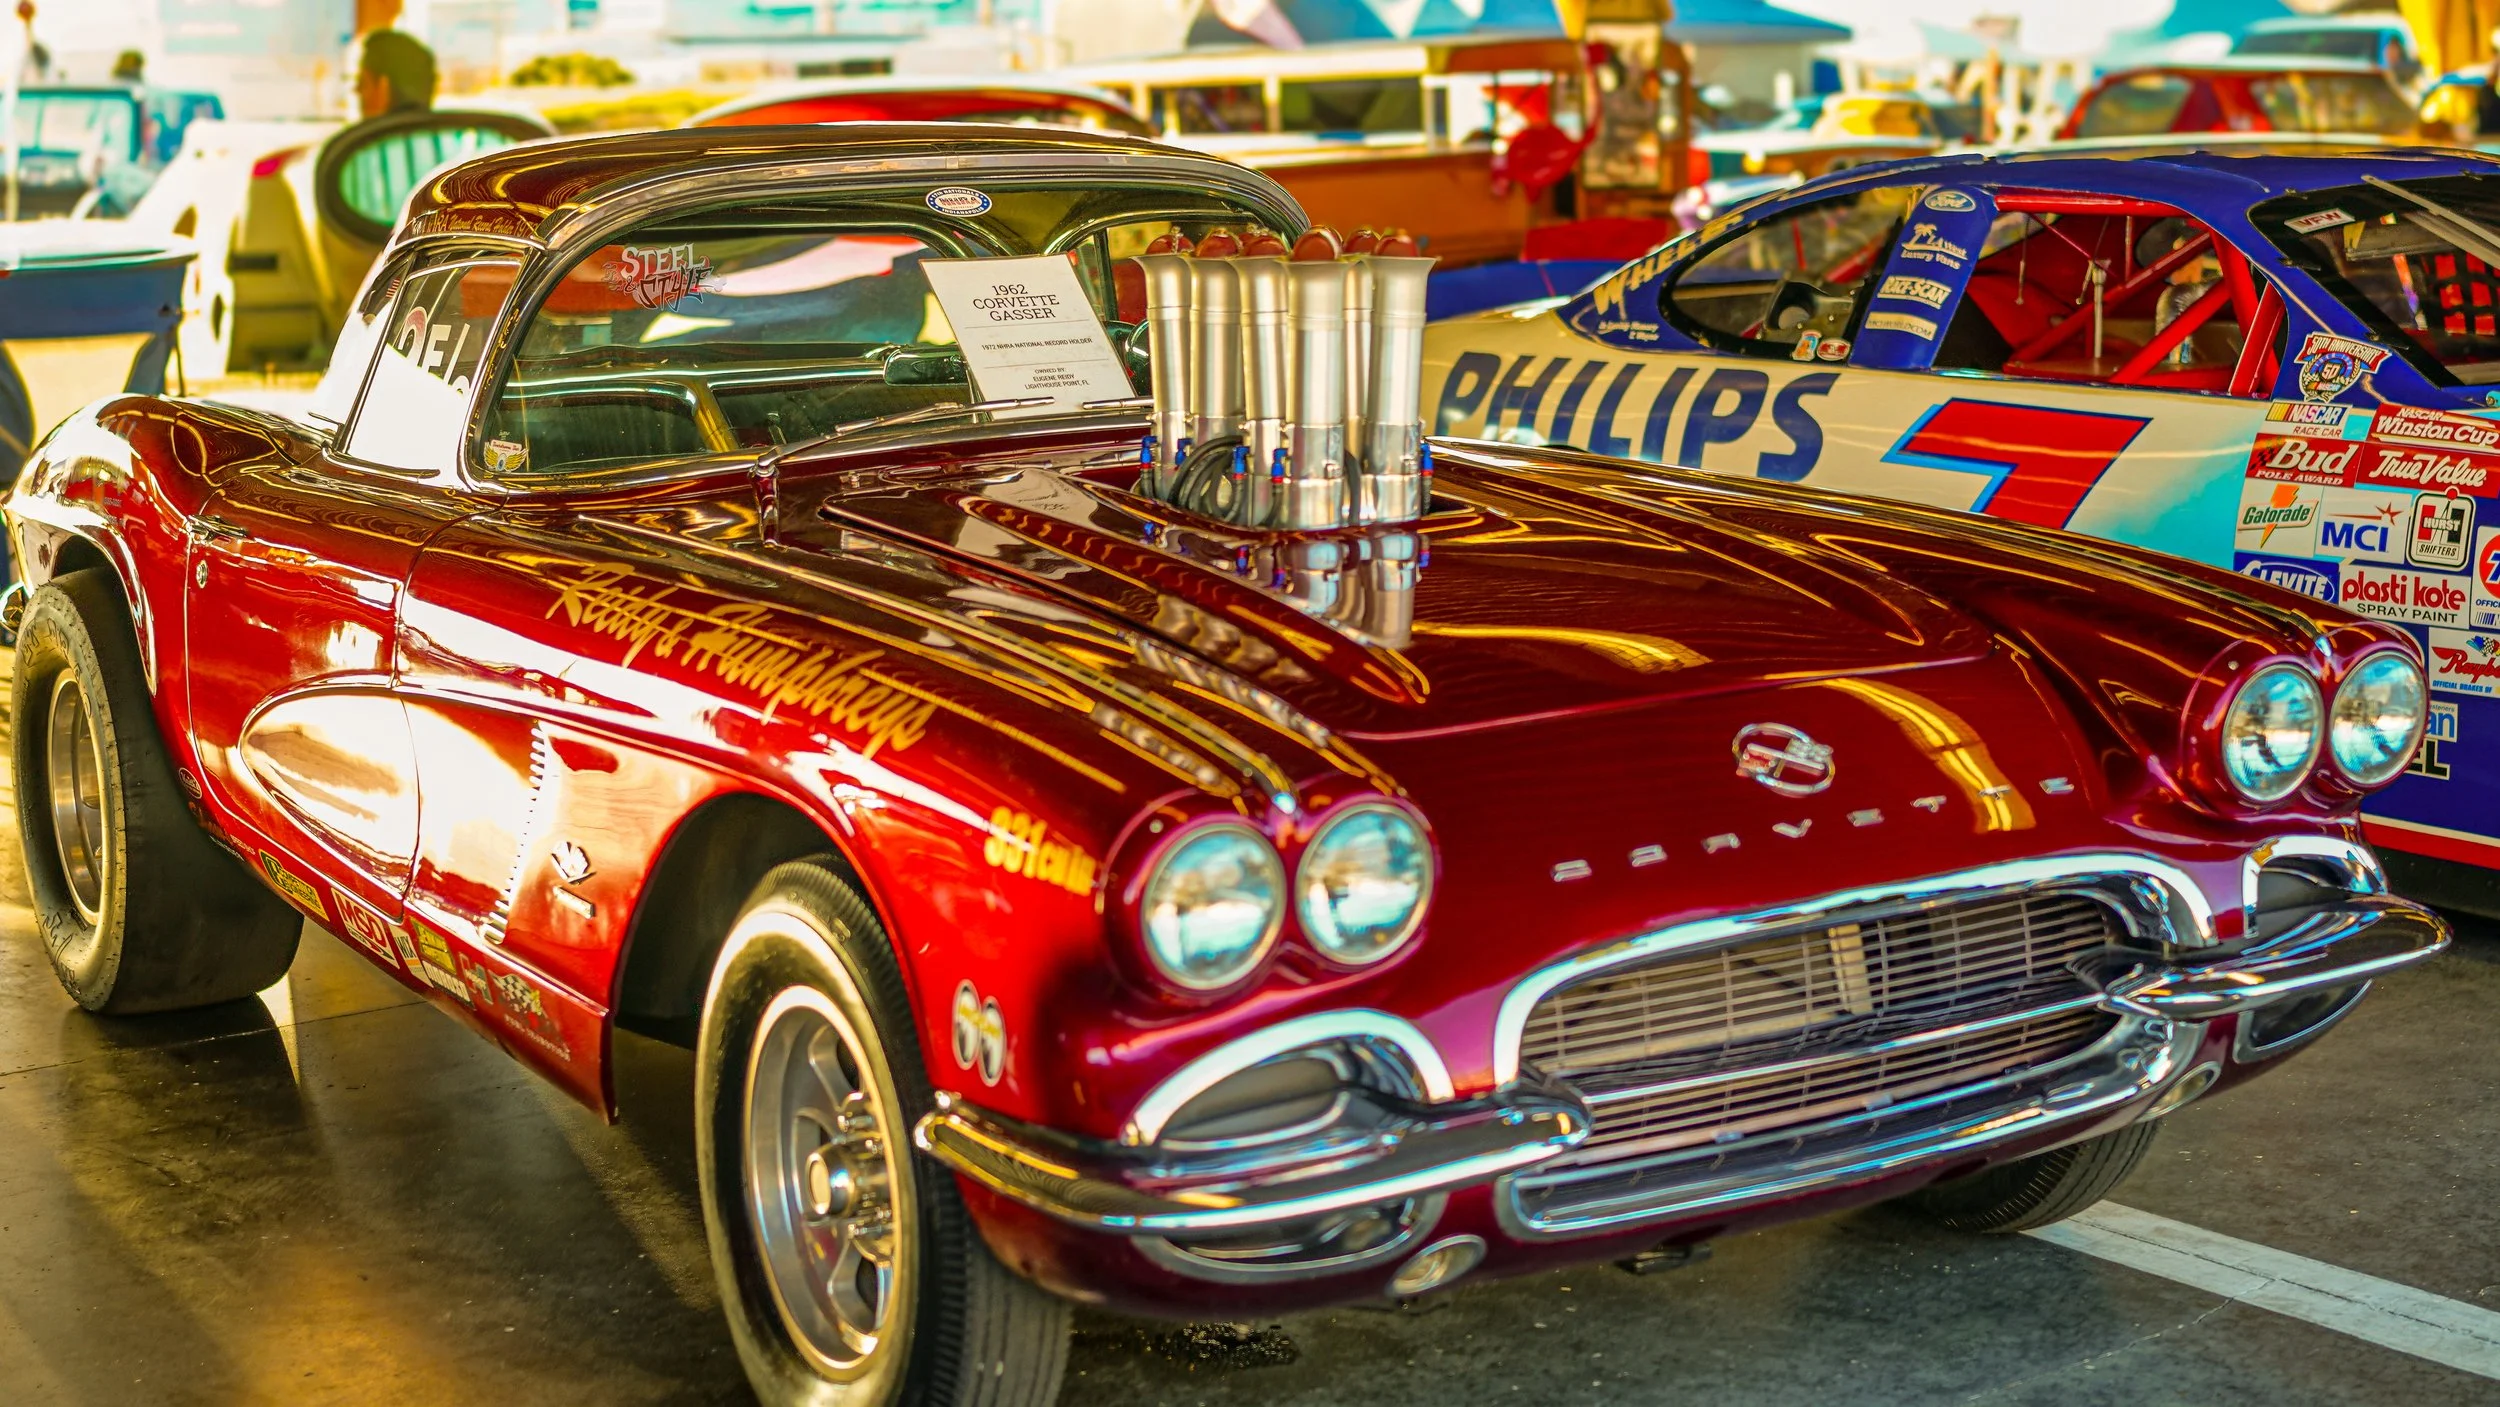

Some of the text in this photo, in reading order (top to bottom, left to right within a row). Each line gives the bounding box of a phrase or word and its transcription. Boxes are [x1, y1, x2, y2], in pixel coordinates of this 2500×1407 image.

[1930, 195, 1968, 208] Ford
[2298, 212, 2341, 226] VFW
[620, 243, 706, 278] STEEL
[992, 283, 1028, 296] 1962
[973, 294, 1060, 309] CORVETTE
[989, 307, 1057, 322] GASSER
[2307, 337, 2381, 364] 50TH ANNIVERSARY
[2321, 363, 2340, 380] 50
[1024, 382, 1062, 390] LIGHTHOUSE
[1433, 350, 1842, 483] PHILIPS
[2286, 404, 2343, 425] NASCAR
[2396, 407, 2444, 421] NASCAR
[2293, 426, 2342, 438] RACE CAR
[2376, 415, 2500, 447] Winston Cup
[1886, 396, 2153, 530] 7
[2265, 438, 2359, 475] Bud
[2255, 469, 2344, 485] POLE AWARD
[2243, 504, 2312, 525] Gatorade
[2423, 516, 2460, 531] HURST
[2321, 521, 2389, 552] MCI
[2419, 543, 2457, 557] SHIFTERS
[2342, 571, 2467, 610] plasti kote
[2357, 603, 2458, 623] SPRAY PAINT
[2432, 679, 2493, 694] OFFICIAL BRAKES OF
[2431, 704, 2455, 713] steners
[1550, 776, 2075, 883] CORVETTE
[335, 891, 388, 949] MSD
